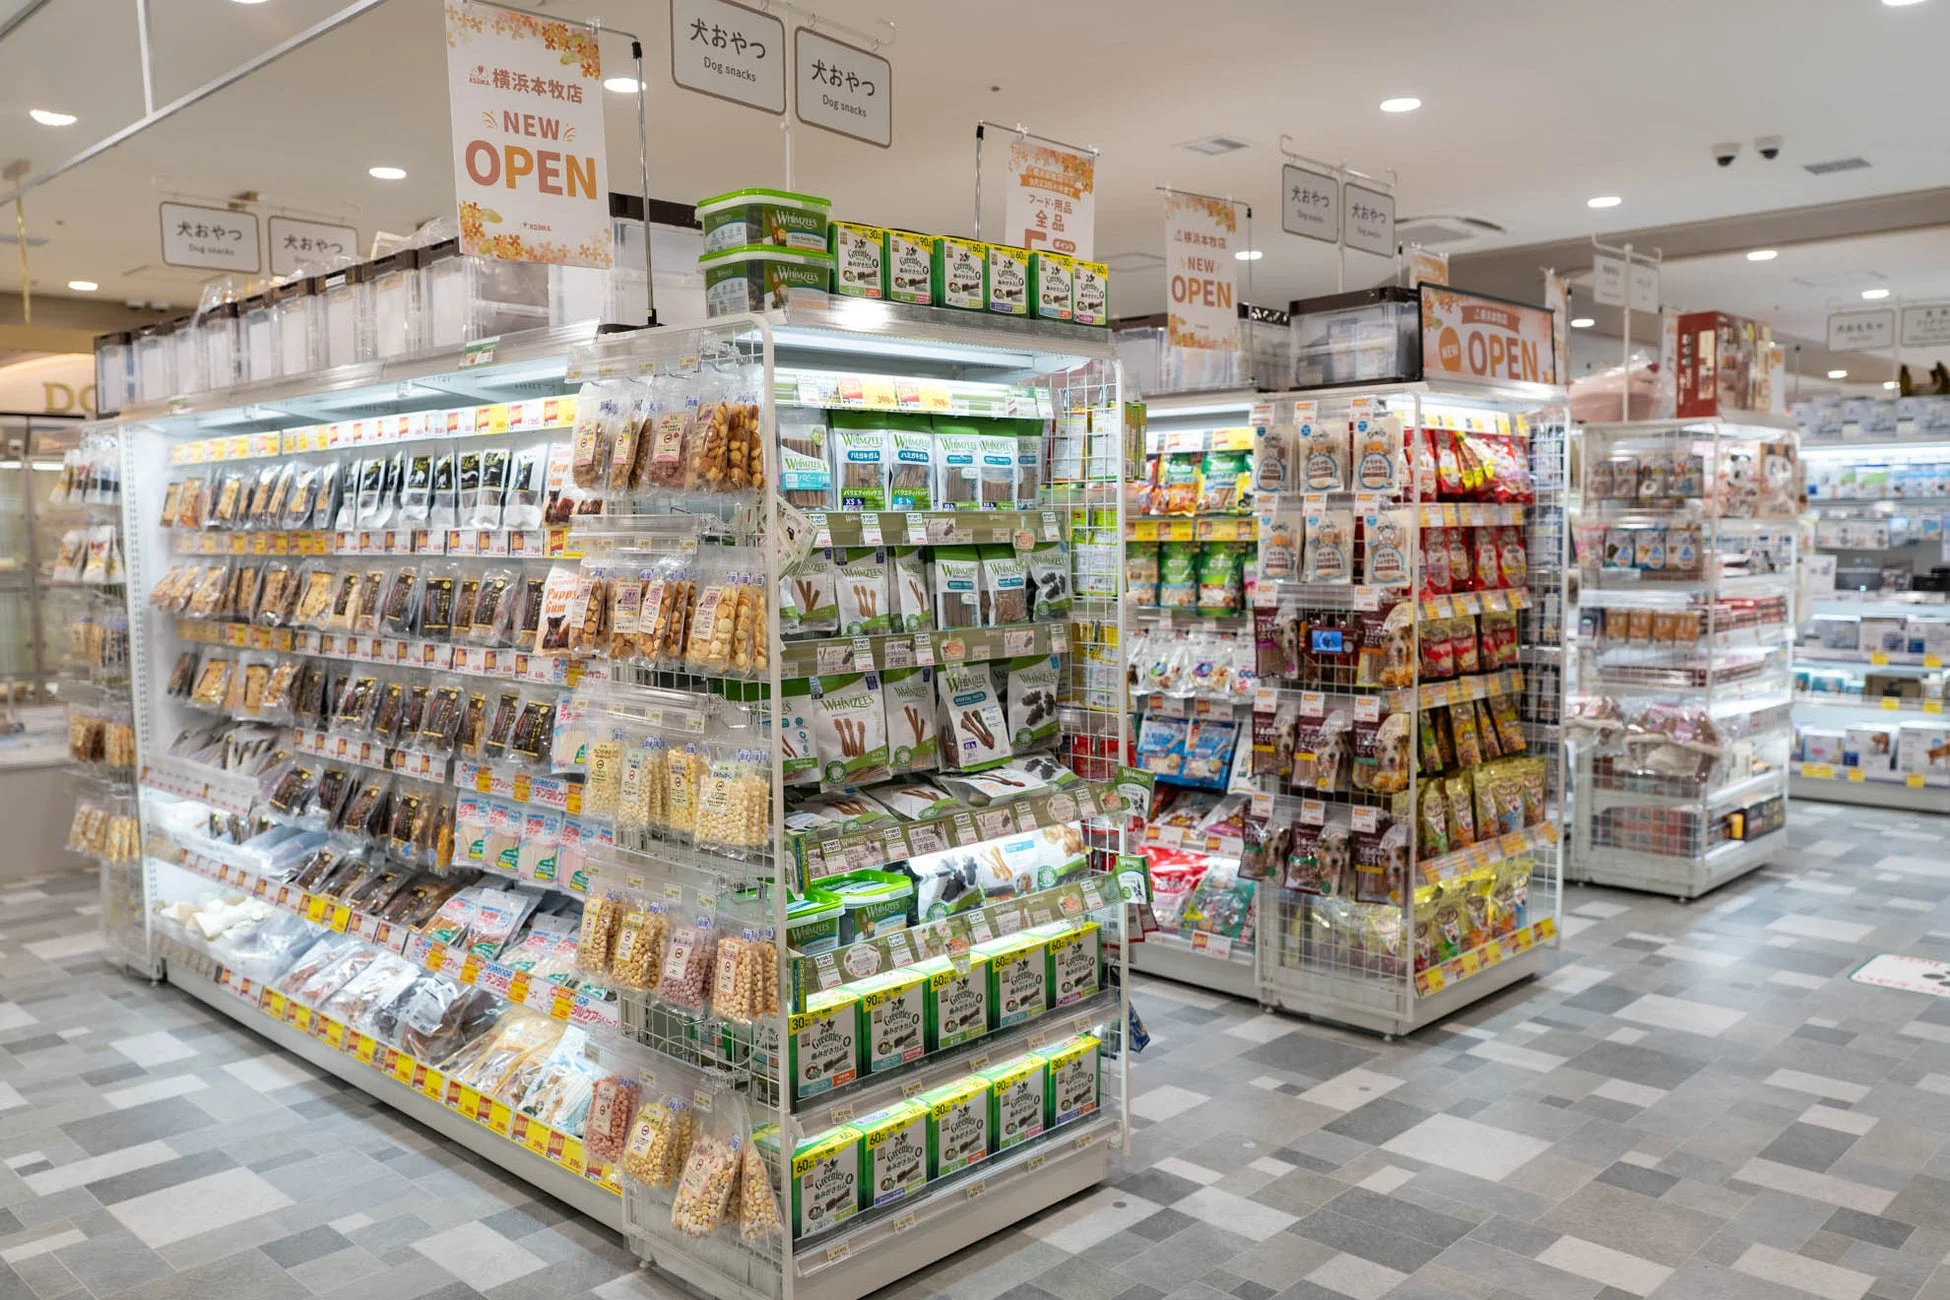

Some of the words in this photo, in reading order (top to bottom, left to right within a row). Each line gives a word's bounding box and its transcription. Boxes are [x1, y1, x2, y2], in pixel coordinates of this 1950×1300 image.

[690, 18, 766, 59] 犬おやつ
[704, 57, 723, 74] Dog
[725, 65, 757, 82] snacks
[811, 59, 875, 97] 犬おやつ
[492, 68, 583, 105] 横浜本牧店
[823, 94, 838, 110] Dog
[840, 101, 867, 118] snacks
[503, 110, 560, 141] NEW
[465, 139, 598, 200] OPEN
[1292, 184, 1330, 208] 犬おやつ
[1036, 209, 1064, 232] 全品
[1352, 202, 1387, 224] 犬おやつ
[176, 221, 243, 241] 犬おやつ
[868, 230, 878, 239] 30
[284, 234, 344, 253] 犬おやつ
[1188, 257, 1215, 274] NEW
[1171, 274, 1232, 309] OPEN
[1468, 330, 1538, 383] OPEN
[547, 588, 577, 601] Puppy
[545, 602, 566, 613] Gum
[821, 695, 874, 711] WHIMZEES
[1051, 941, 1060, 950] 60
[995, 957, 1004, 968] 60
[934, 976, 944, 986] 60
[866, 995, 877, 1006] 90
[792, 1017, 804, 1030] 30
[1053, 1059, 1062, 1069] 30
[996, 1080, 1006, 1091] 90
[935, 1104, 945, 1116] 30
[870, 1133, 880, 1145] 60
[797, 1160, 808, 1173] 60
